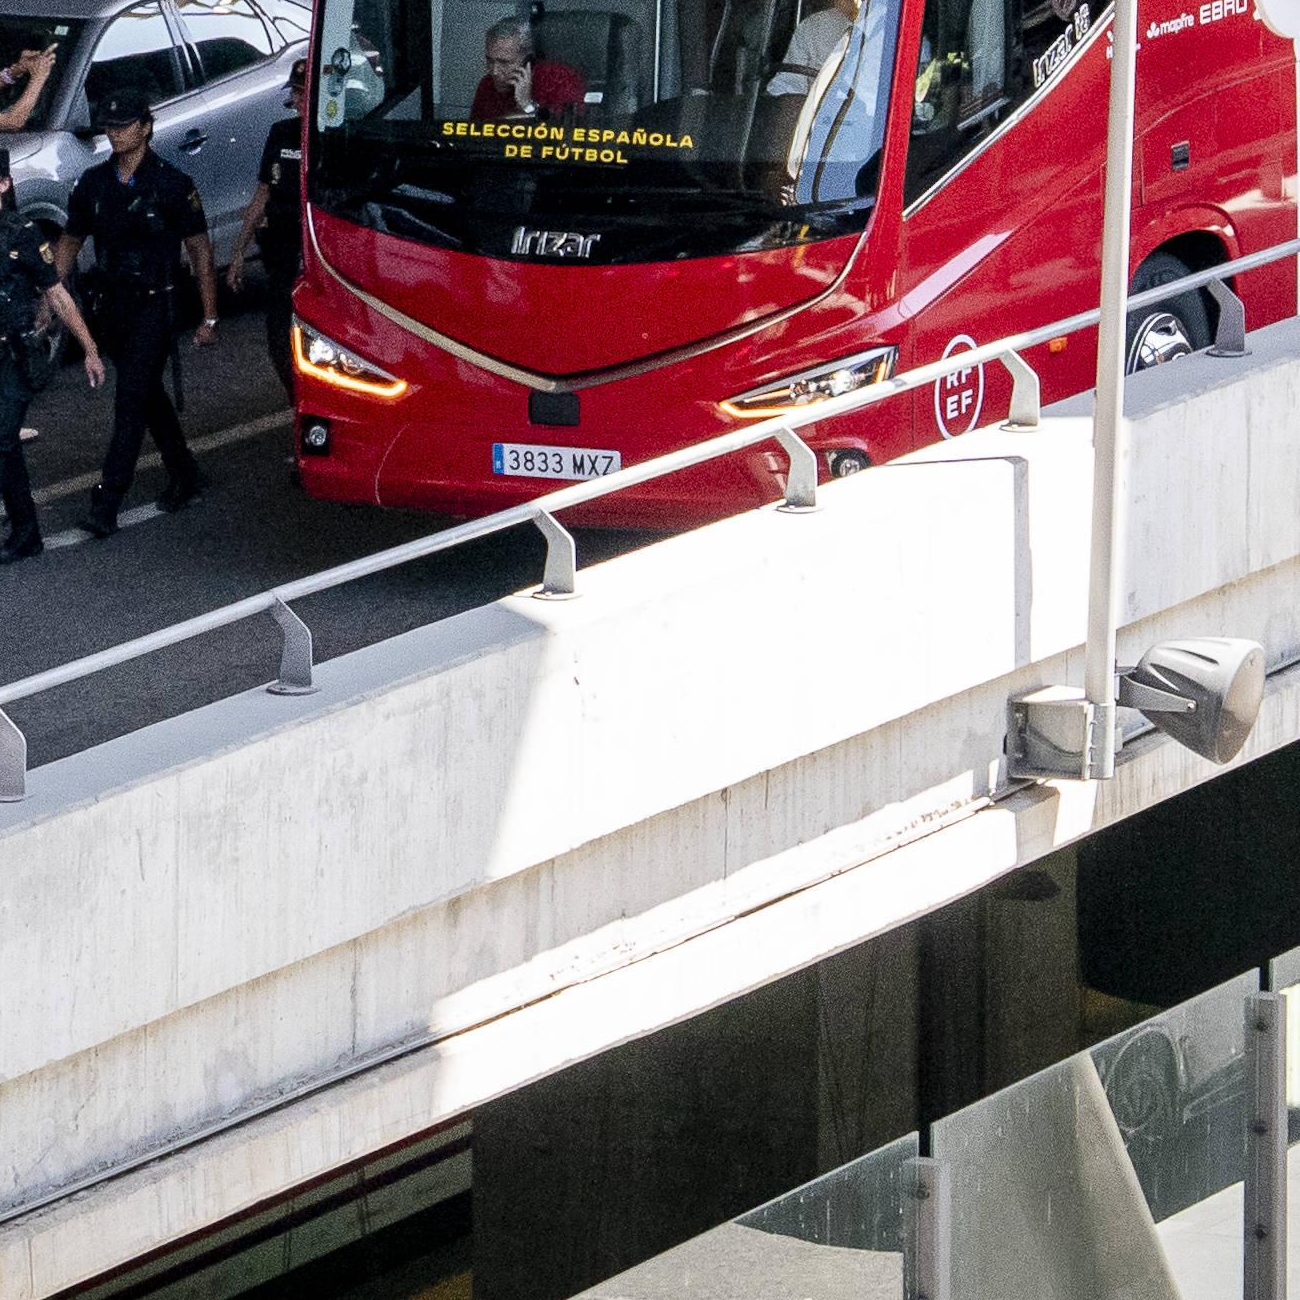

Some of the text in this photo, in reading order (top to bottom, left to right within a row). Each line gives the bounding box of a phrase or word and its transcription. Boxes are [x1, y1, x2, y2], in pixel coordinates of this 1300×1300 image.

[1160, 12, 1195, 35] mapfre
[443, 122, 694, 148] SELECCIÓN ESPAÑOLA
[505, 143, 629, 164] DE FÚTBOL
[946, 389, 974, 420] EF
[508, 449, 614, 476] 3833 MXZ
